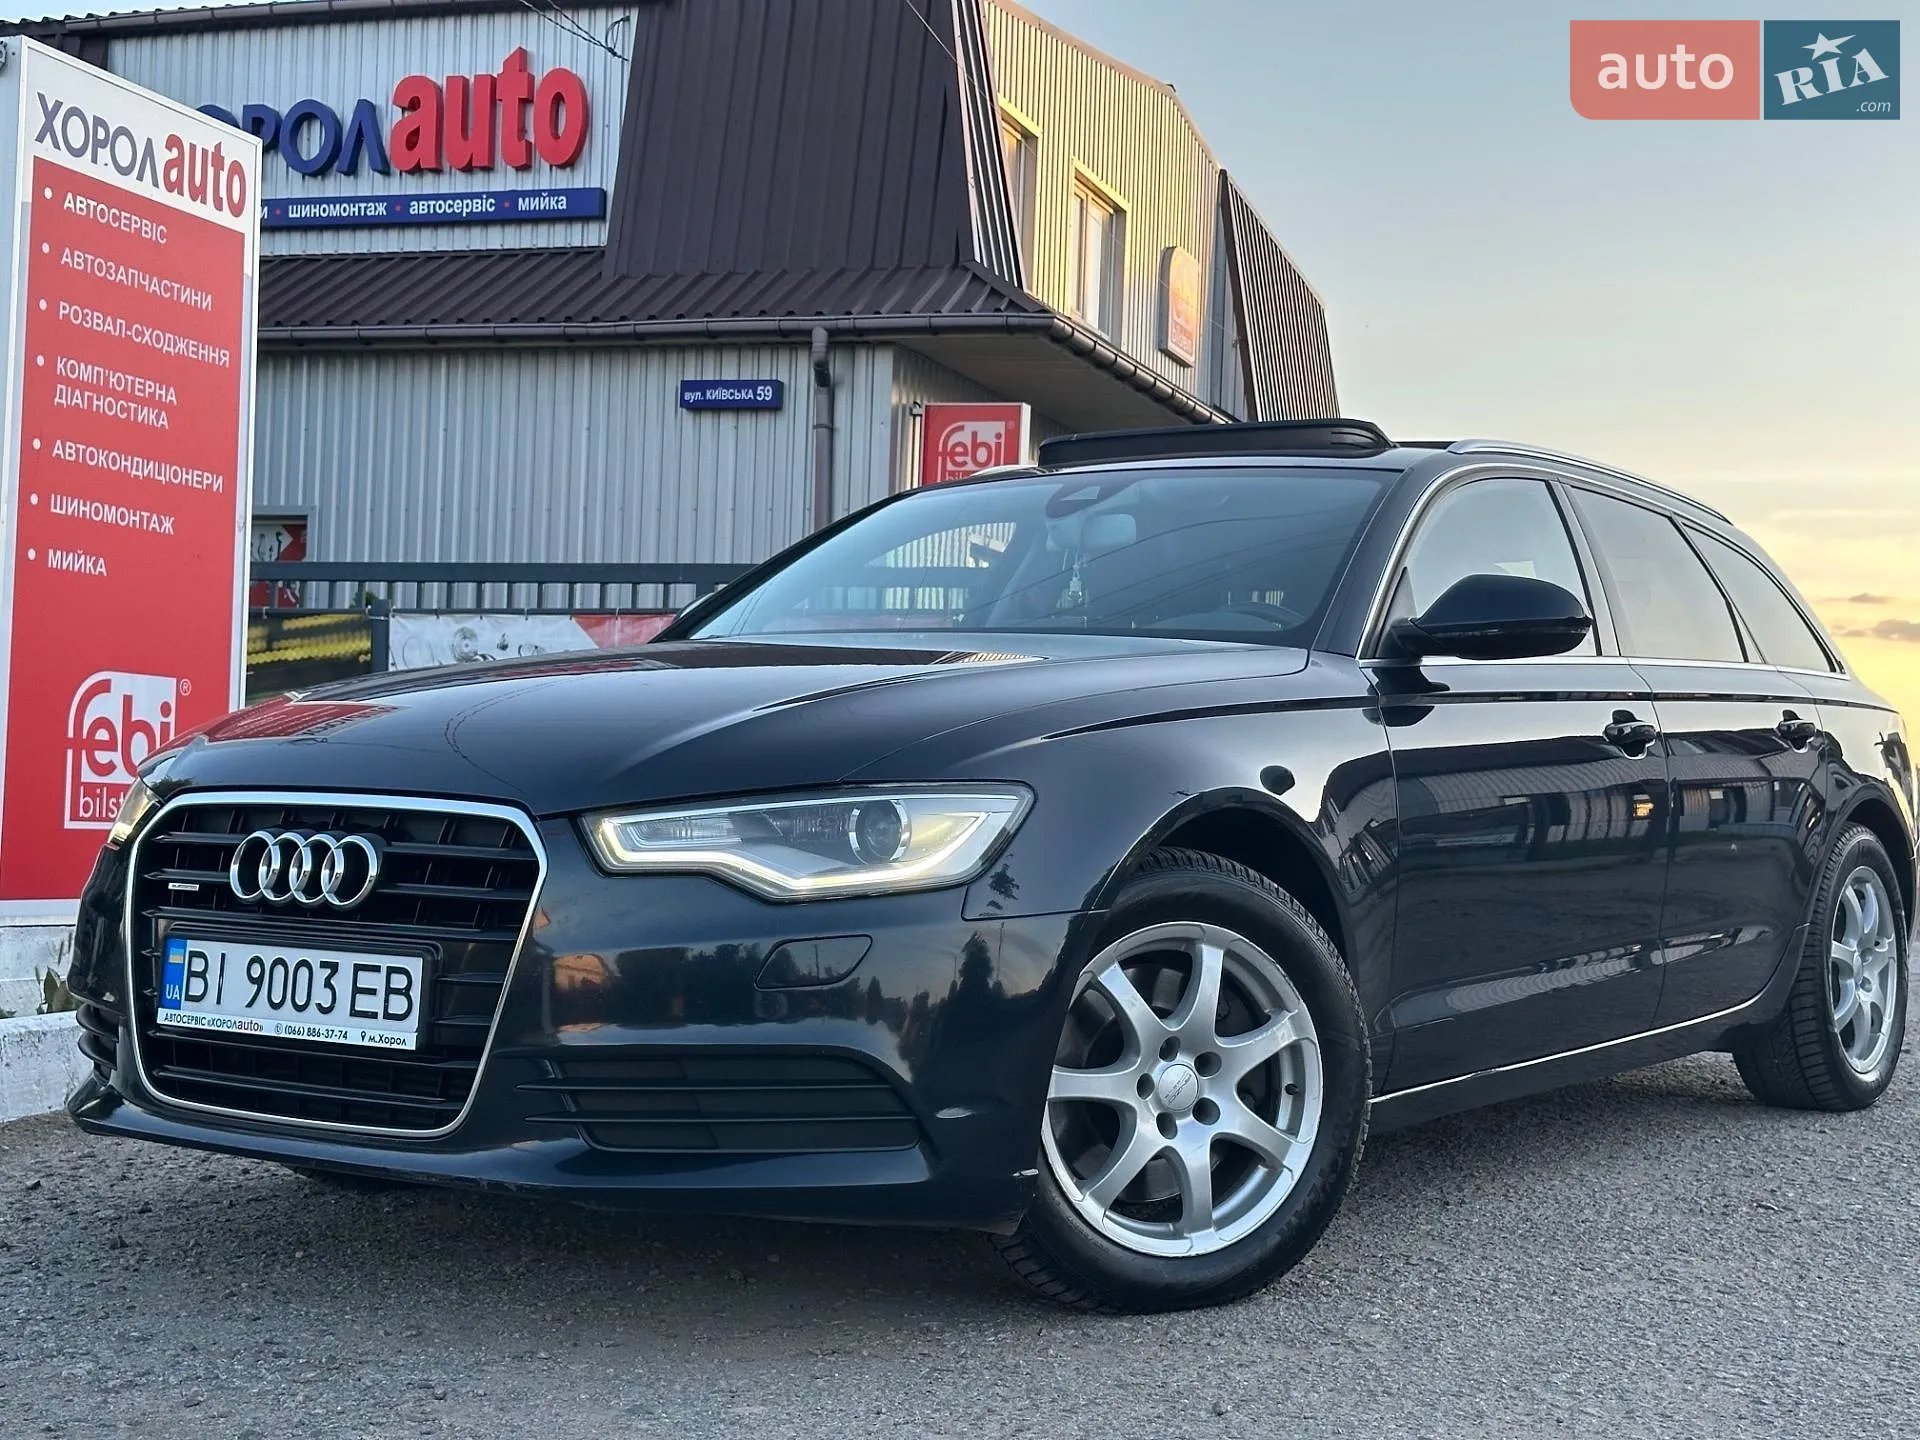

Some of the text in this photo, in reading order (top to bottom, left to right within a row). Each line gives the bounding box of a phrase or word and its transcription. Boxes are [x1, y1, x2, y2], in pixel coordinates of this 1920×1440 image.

[63, 191, 168, 244] АВТОСЕРВІС
[288, 202, 388, 218] шиномонтаж
[409, 194, 496, 217] автосервіс
[518, 192, 567, 211] мийка
[60, 247, 213, 311] АВТОЗАПЧАСТИНИ
[59, 301, 230, 368] РОЗВАЛ-СХОДЖЕННЯ
[56, 356, 178, 405] КОМП'ЮТЕРНА
[684, 386, 773, 403] вул. КИЇВСЬКА 59
[54, 384, 170, 430] ДІАГНОСТИКА
[52, 439, 224, 493] АВТОКОНДИЦІОНЕРИ
[938, 424, 1003, 470] febi
[50, 493, 175, 535] ШИНОМОНТАЖ
[48, 548, 108, 577] МИЙКА
[67, 678, 172, 783] febi
[165, 984, 180, 1000] UA
[245, 955, 339, 1015] 9003
[164, 1012, 207, 1026] АВТОСЕРВІС
[284, 1024, 305, 1037] (066)
[306, 1027, 348, 1040] 886-37-74
